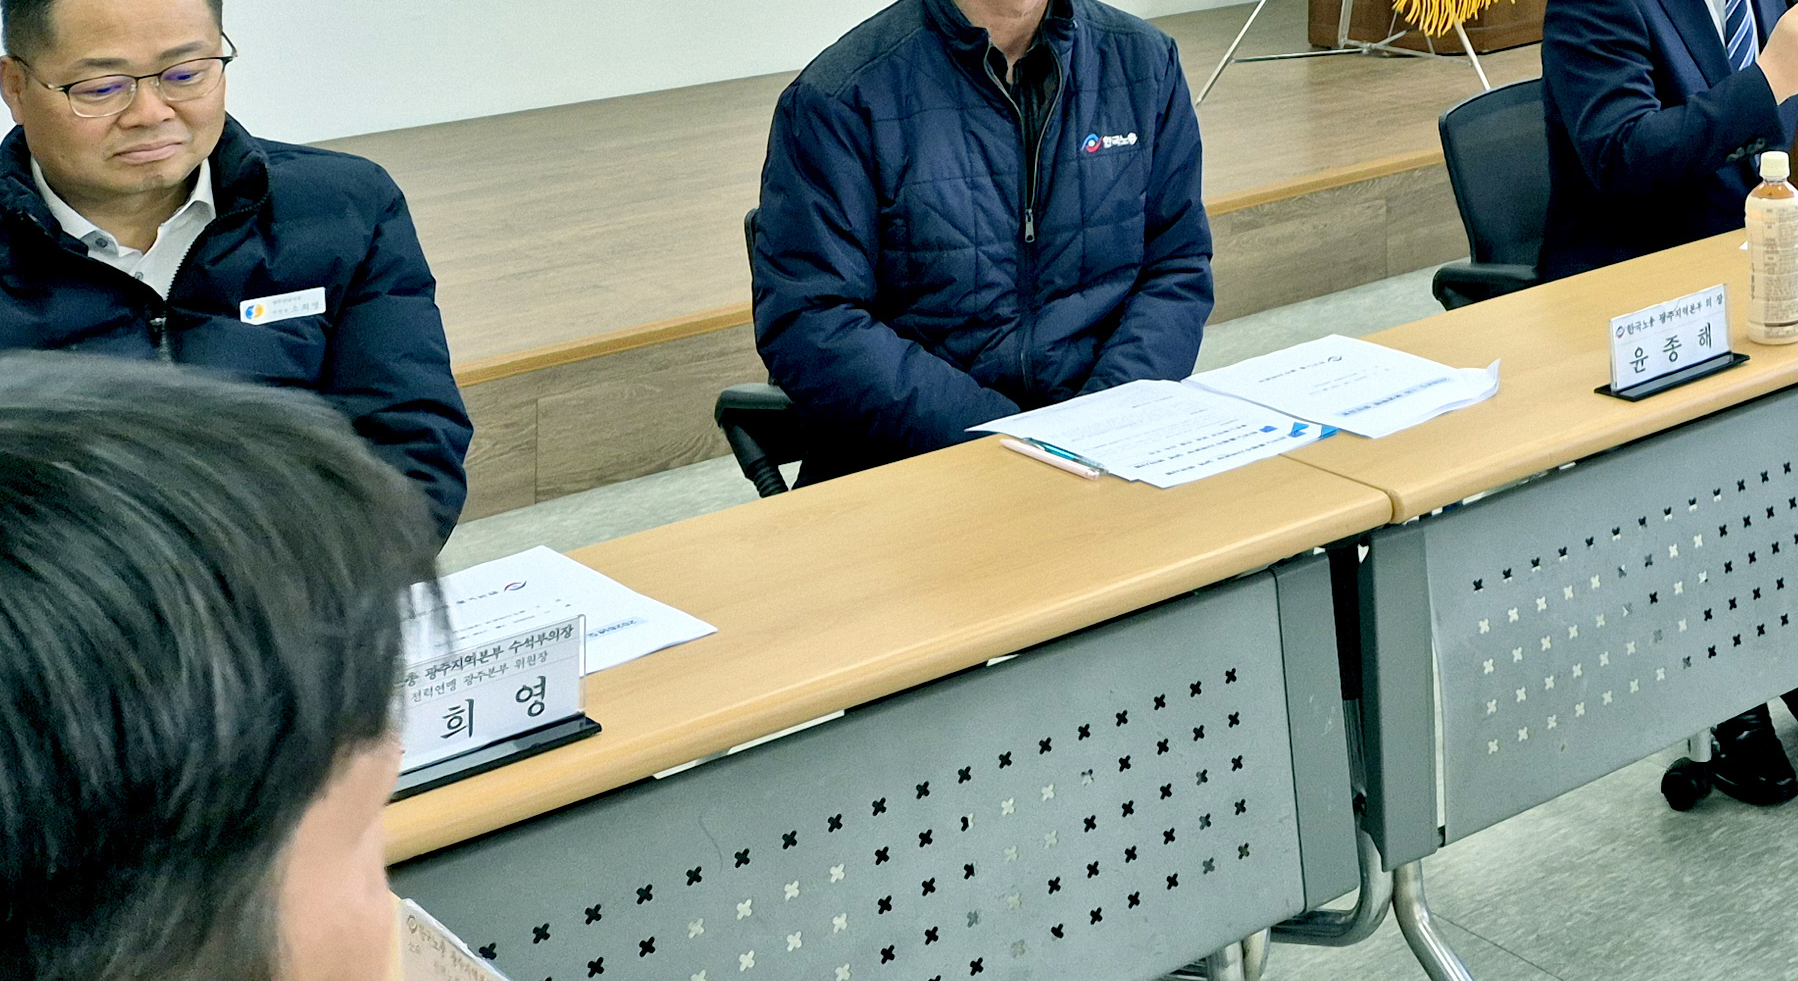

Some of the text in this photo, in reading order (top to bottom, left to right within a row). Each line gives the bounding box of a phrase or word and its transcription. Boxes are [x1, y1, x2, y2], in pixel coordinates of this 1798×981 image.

[424, 645, 505, 681] 광주지역본부
[508, 623, 574, 655] 수석부의장
[514, 650, 549, 670] 위원장
